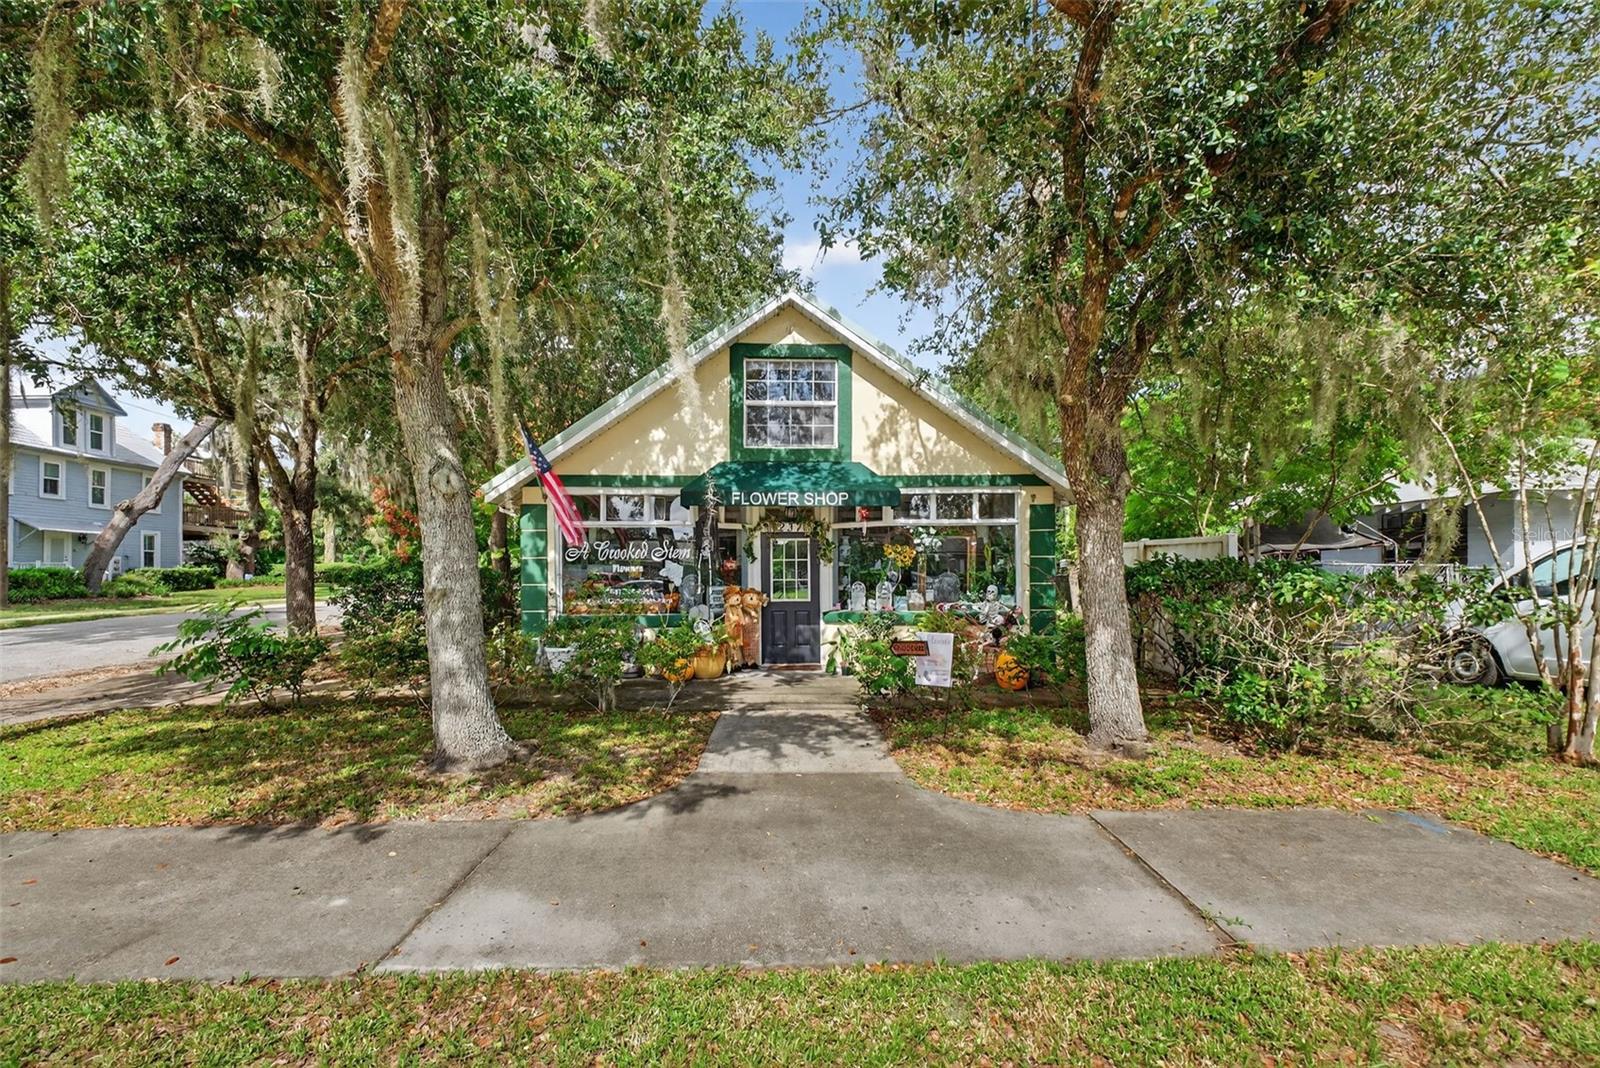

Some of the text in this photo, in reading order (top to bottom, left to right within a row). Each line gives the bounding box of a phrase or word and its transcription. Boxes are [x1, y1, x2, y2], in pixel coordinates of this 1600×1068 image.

[731, 491, 849, 506] FLOWER SHOP
[565, 539, 691, 562] A Crooked Stem
